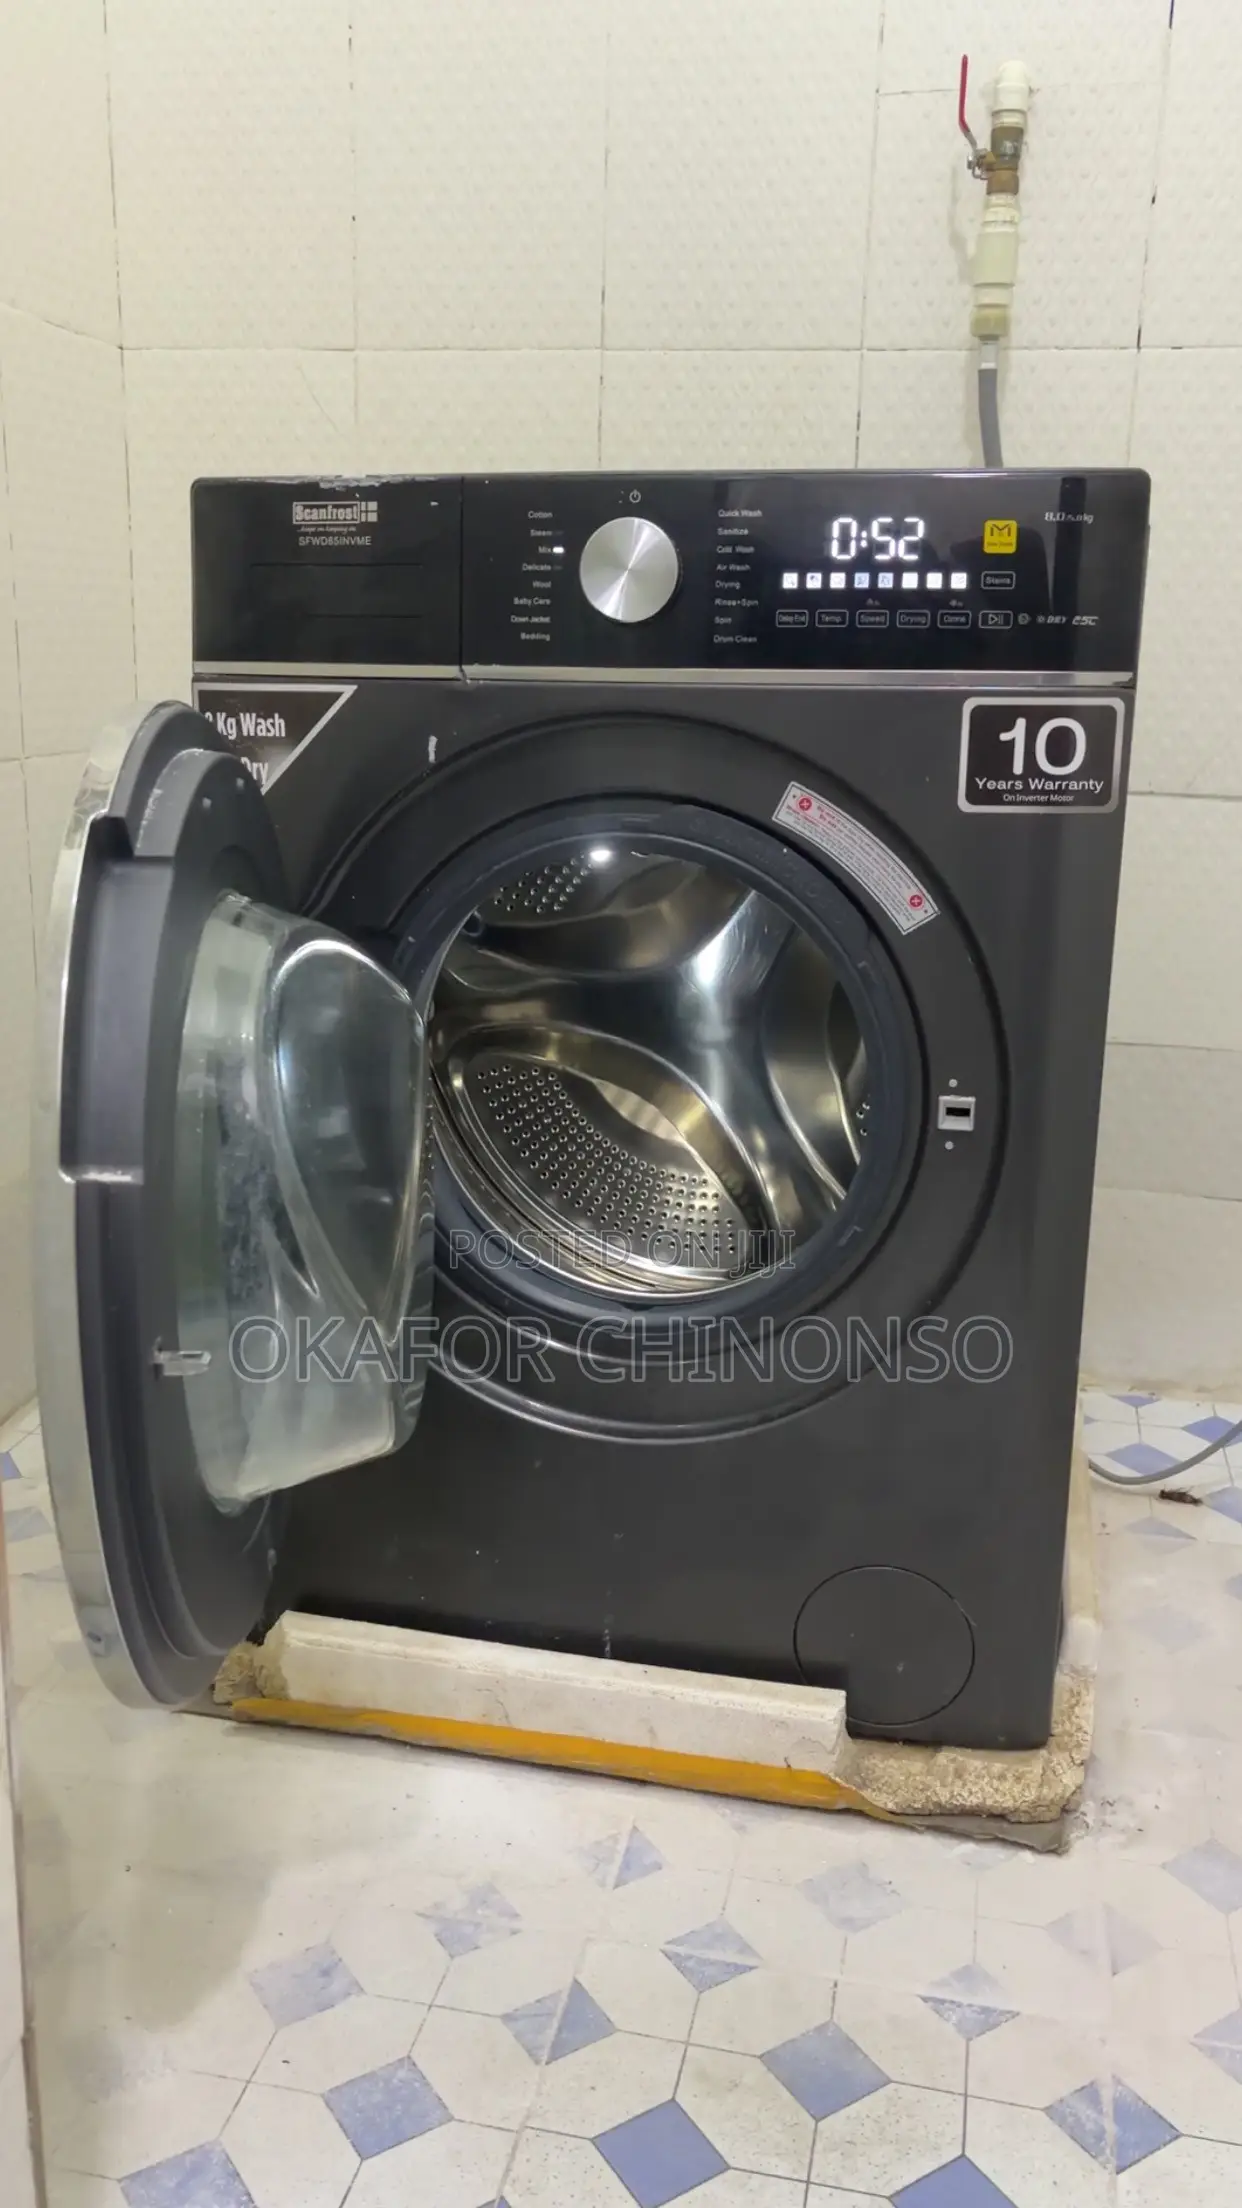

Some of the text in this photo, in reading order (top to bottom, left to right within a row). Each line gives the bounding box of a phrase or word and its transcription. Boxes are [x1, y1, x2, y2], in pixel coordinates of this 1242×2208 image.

[294, 504, 358, 520] Scanfrost
[527, 510, 553, 519] Cotton
[717, 508, 762, 518] Quick Wash
[831, 516, 925, 561] 0:52
[521, 562, 552, 571] Delicate
[728, 563, 751, 571] Wash
[532, 580, 552, 588] Wool
[714, 580, 741, 590] Drying
[513, 596, 551, 608] Baby Care
[714, 616, 732, 625] Spin
[520, 631, 551, 642] Bedding
[713, 634, 734, 643] Drum
[216, 711, 286, 740] Kg Wash
[999, 716, 1087, 776] 10
[975, 777, 1104, 794] Years Warranty
[1003, 793, 1075, 803] On Inverter Motor
